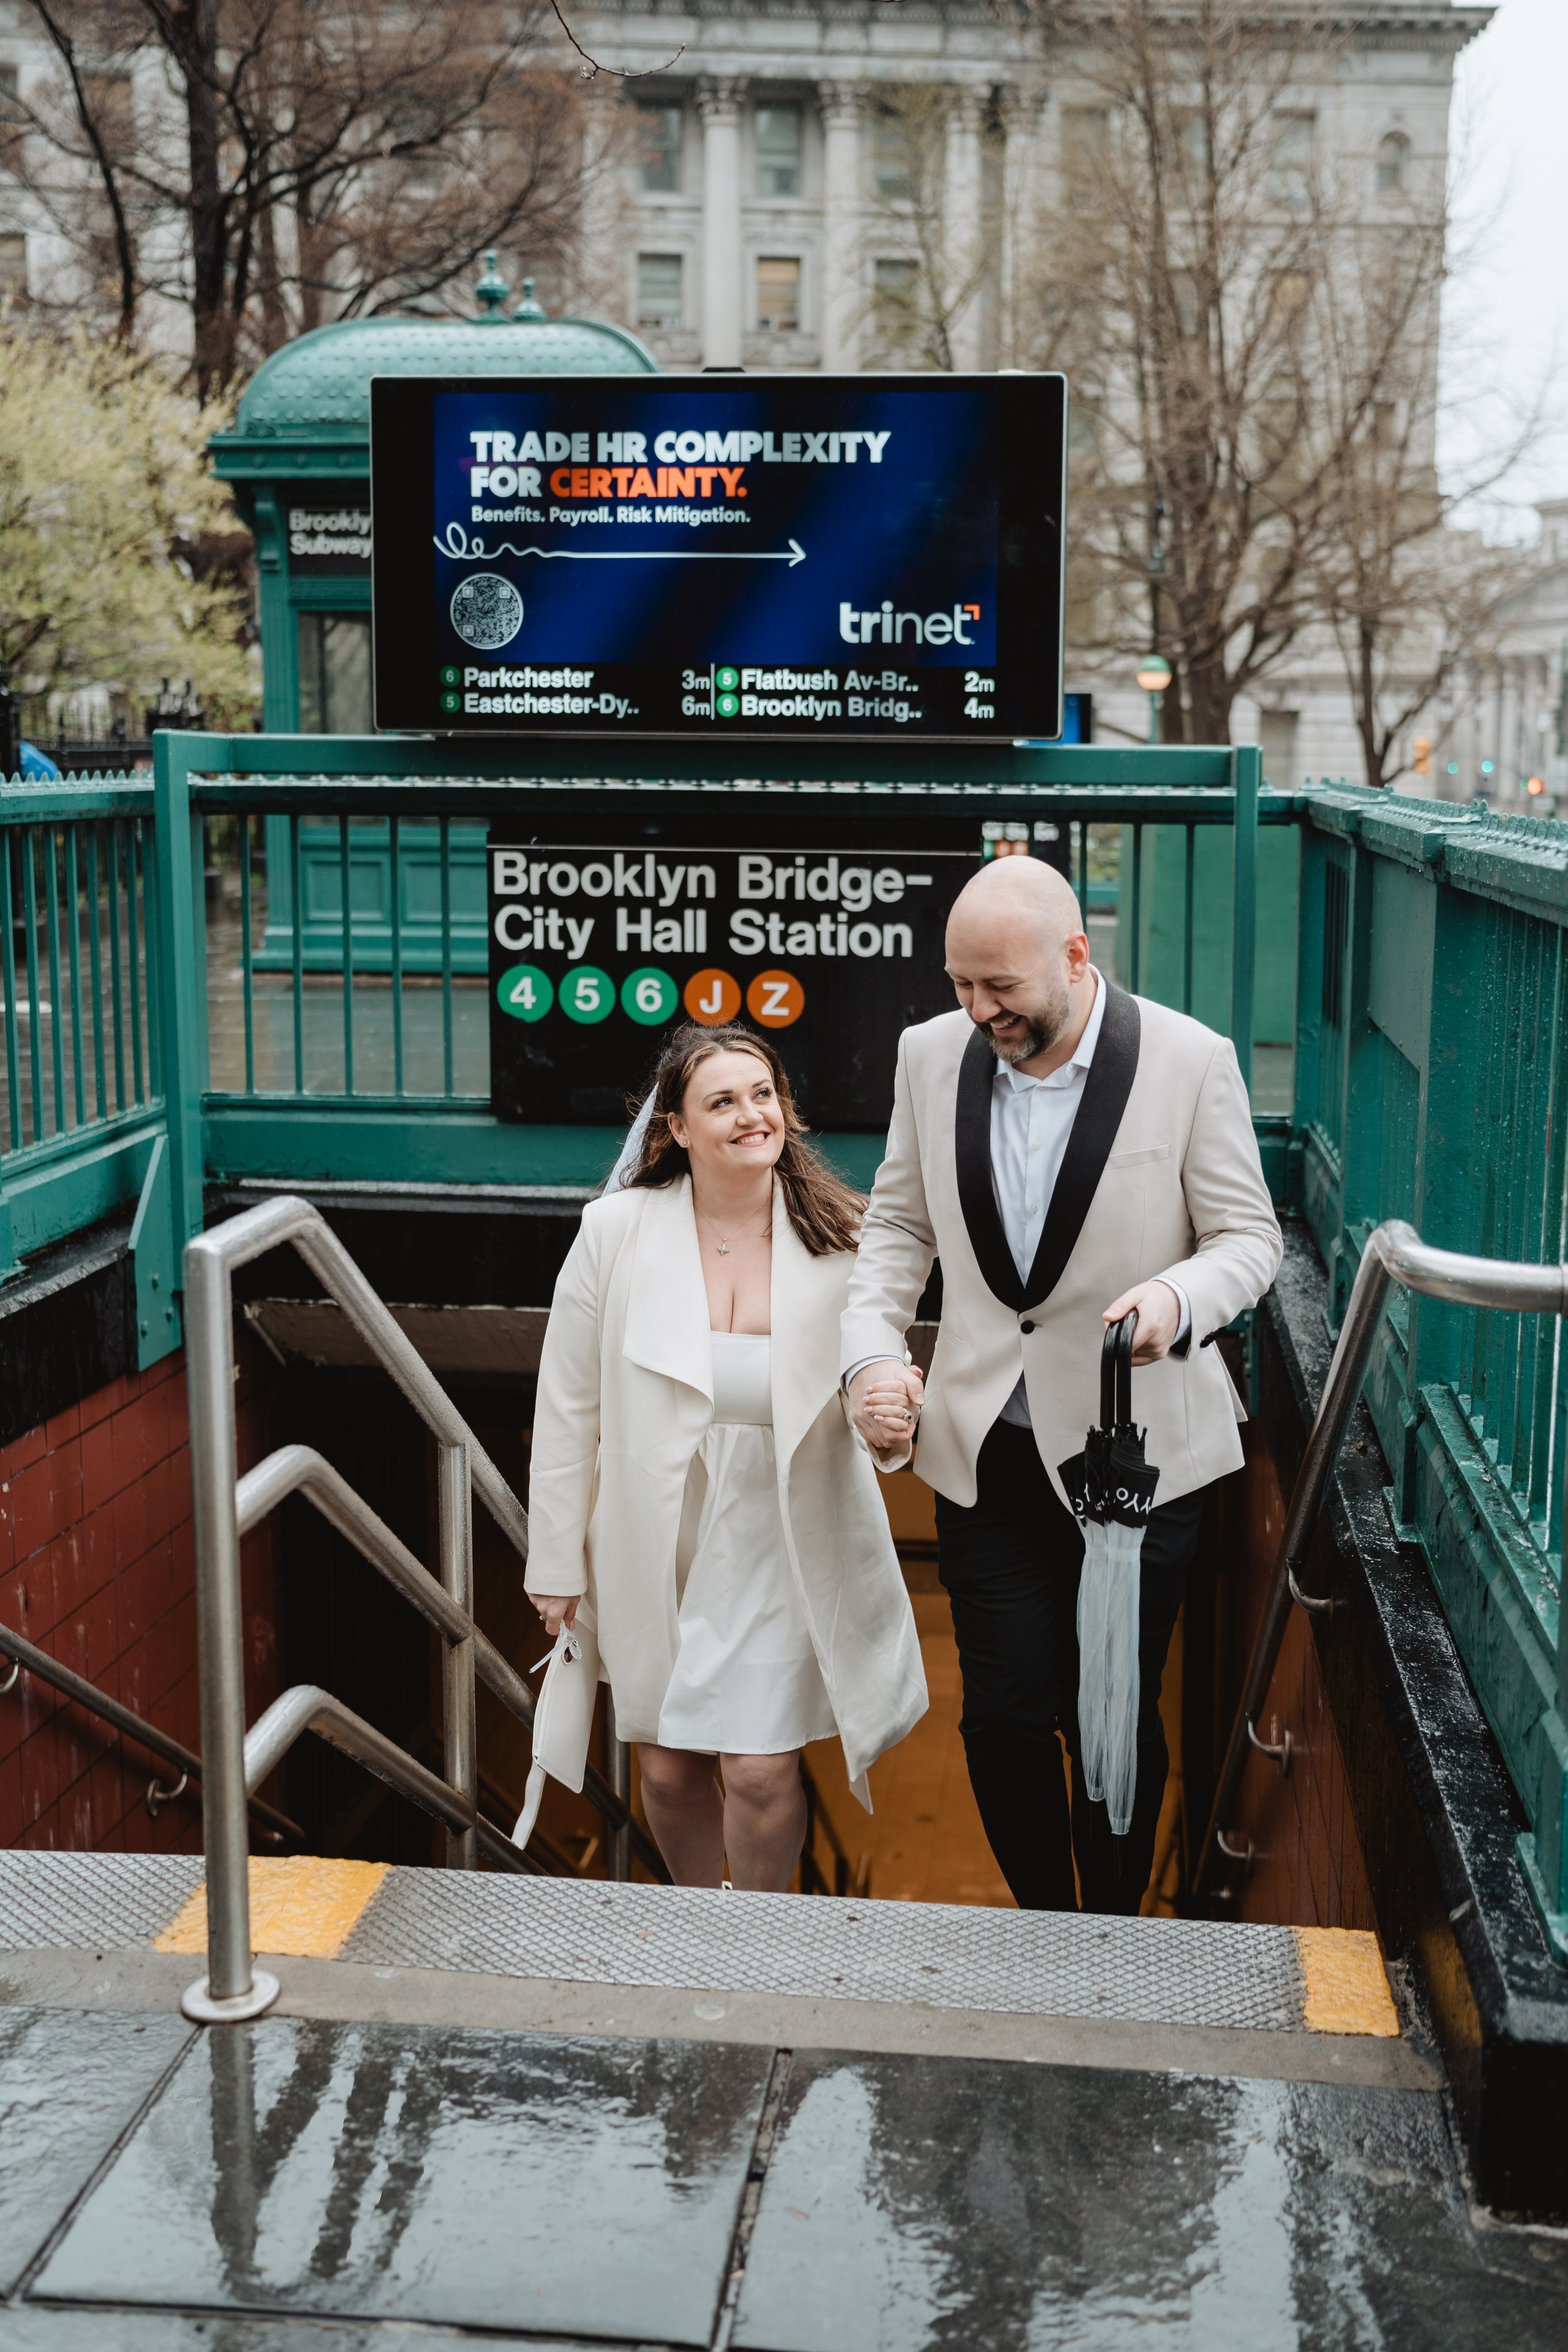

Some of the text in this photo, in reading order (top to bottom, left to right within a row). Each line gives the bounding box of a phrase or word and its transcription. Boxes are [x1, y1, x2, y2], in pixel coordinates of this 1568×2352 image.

[470, 430, 892, 464] TRADE HR COMPLEXITY
[470, 466, 747, 498] FOR CERTAINTY.
[471, 505, 751, 527] Benefits. Payroll. Risk Mitigation.
[290, 532, 371, 559] Subway
[839, 600, 980, 646] trinet
[445, 666, 710, 690] 6 Parkchester 3m
[722, 671, 733, 687] 5
[741, 668, 839, 690] Flatbush
[963, 671, 995, 693] 2m
[445, 695, 455, 709] 5
[681, 695, 710, 716] 6m
[722, 695, 995, 722] 6 Brooklyn Bridg.. 4m
[493, 851, 933, 912] Brooklyn Bridge-
[494, 903, 913, 960] City Hall Station
[509, 976, 790, 1016] 4 5 6 J Z
